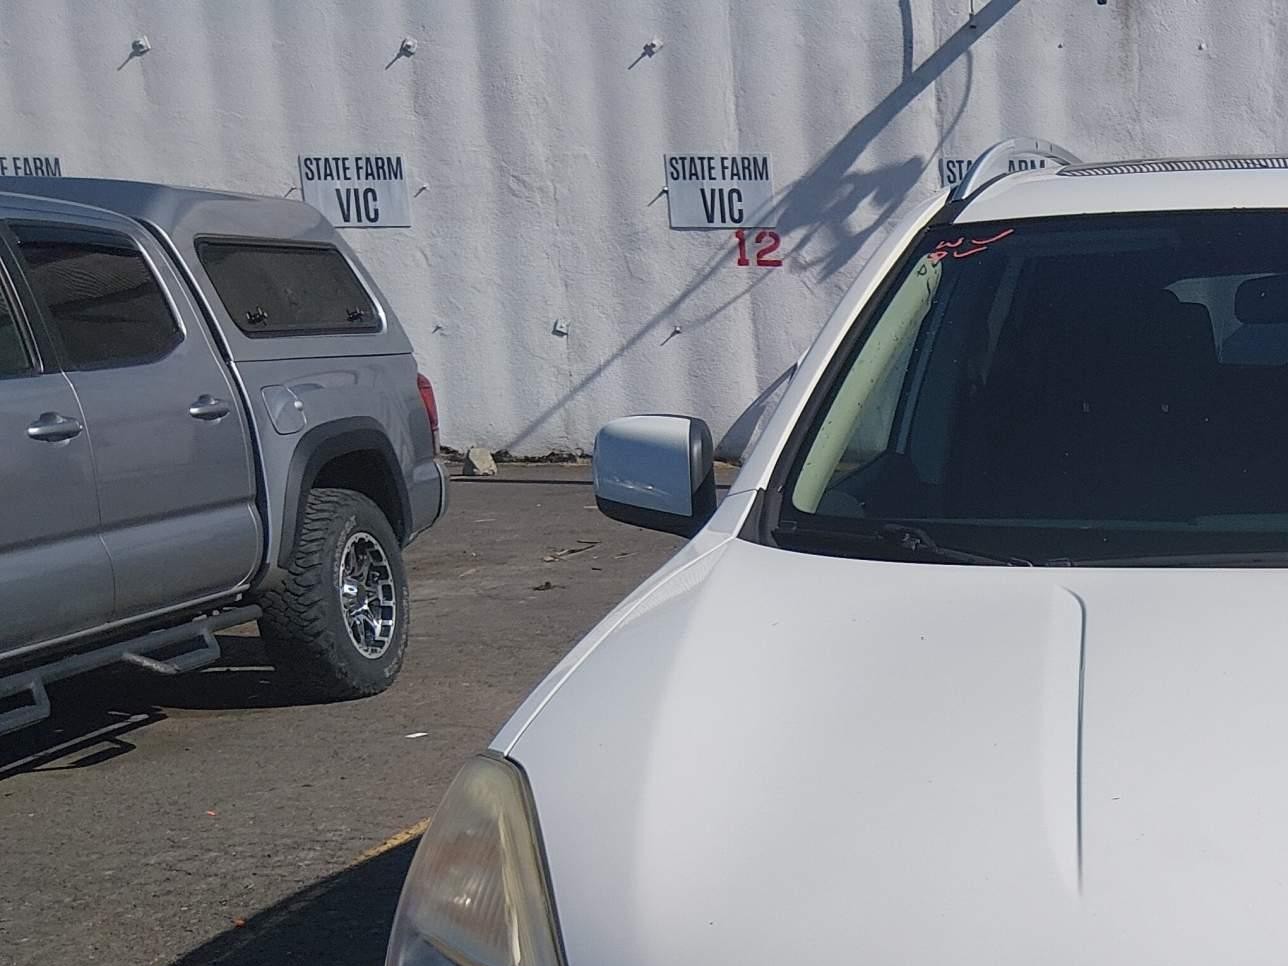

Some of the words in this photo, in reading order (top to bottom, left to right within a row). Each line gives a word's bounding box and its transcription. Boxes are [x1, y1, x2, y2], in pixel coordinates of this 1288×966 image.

[12, 157, 62, 176] FARM
[303, 157, 352, 181] STATE
[355, 157, 403, 181] FARM
[669, 156, 717, 181] STATE
[720, 156, 769, 181] FARM
[335, 187, 379, 223] VIC
[700, 188, 744, 224] VIC
[735, 230, 783, 266] 12
